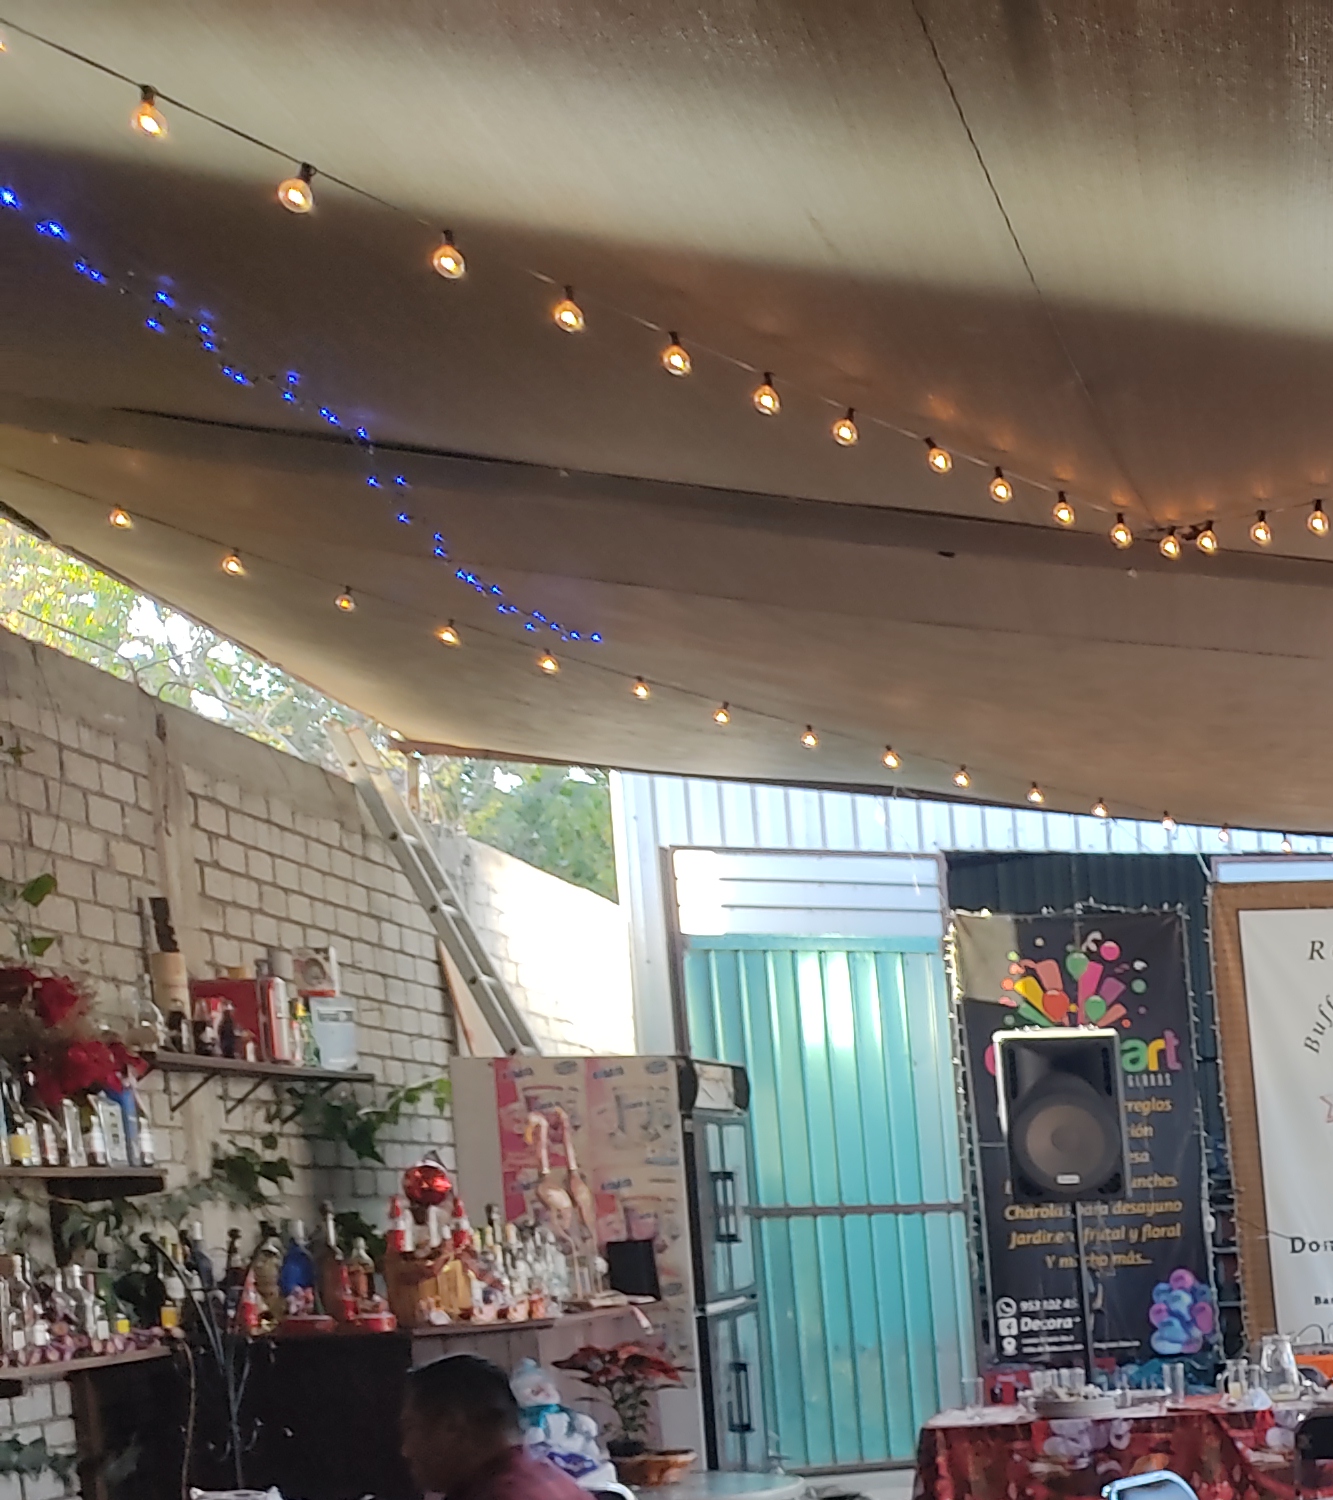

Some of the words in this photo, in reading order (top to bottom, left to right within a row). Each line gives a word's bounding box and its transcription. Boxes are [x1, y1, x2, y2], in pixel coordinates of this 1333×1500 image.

[1112, 1200, 1183, 1218] desayuno
[1128, 1227, 1139, 1244] y
[1141, 1222, 1182, 1244] floral
